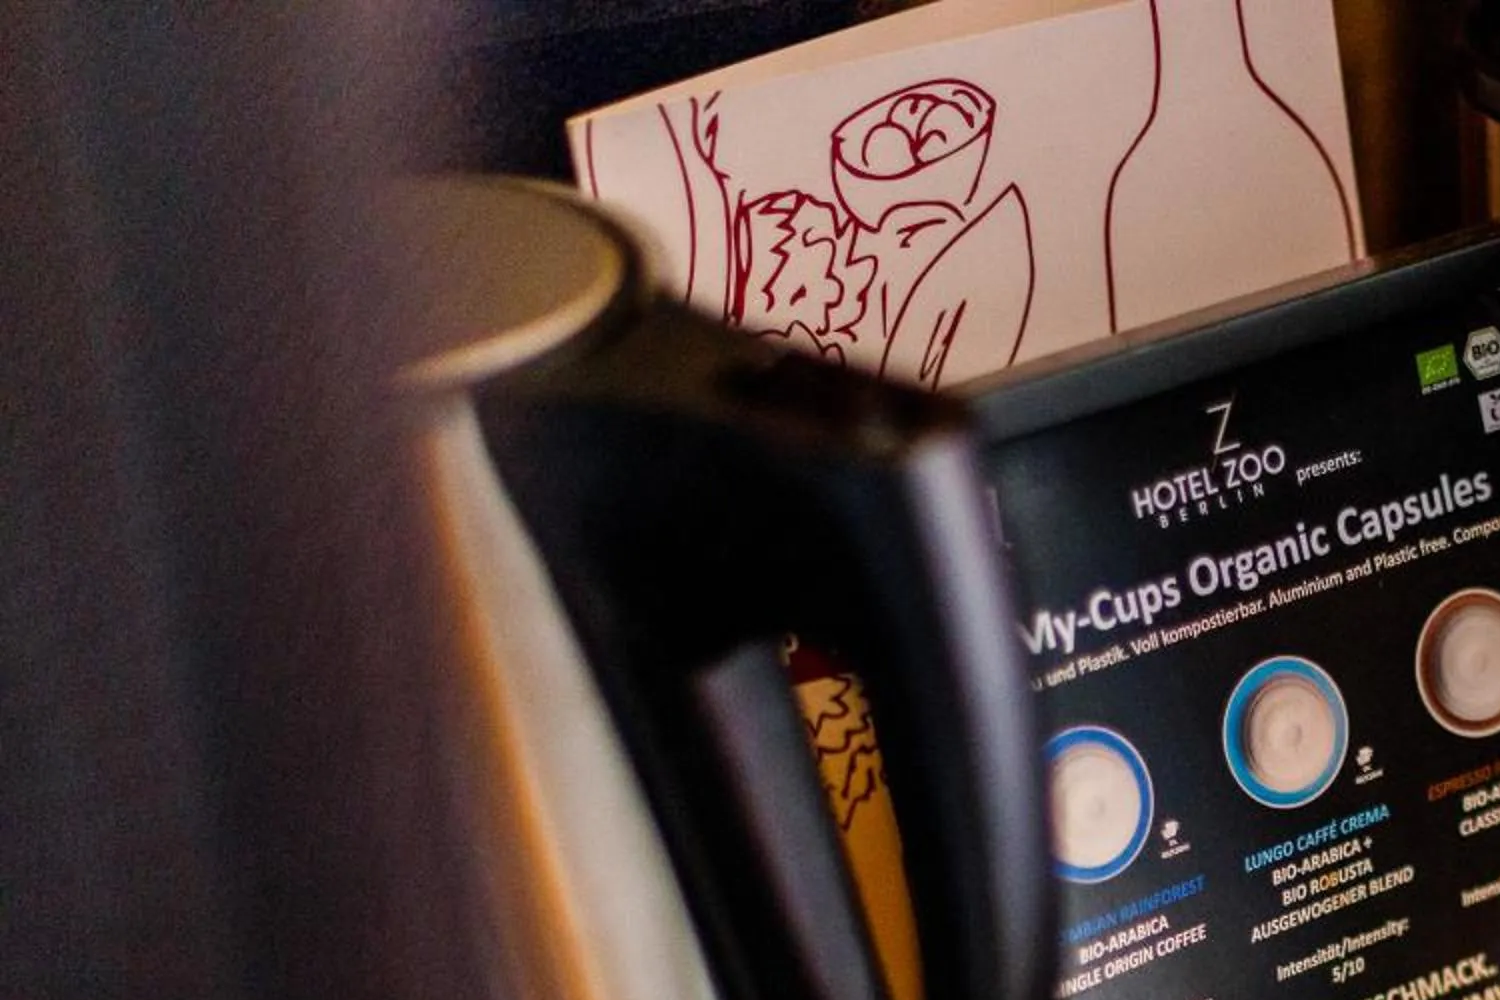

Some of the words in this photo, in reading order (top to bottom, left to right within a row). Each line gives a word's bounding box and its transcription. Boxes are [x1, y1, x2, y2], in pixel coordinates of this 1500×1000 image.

[1471, 340, 1500, 361] BIO
[1205, 399, 1242, 456] Z
[1131, 466, 1219, 519] HOTEL
[1222, 445, 1286, 490] ZOO
[1296, 450, 1362, 487] presents:
[1159, 483, 1265, 529] BERLIN
[1188, 521, 1330, 592] Organic
[1336, 469, 1493, 546] Capsules
[1047, 662, 1077, 687] und
[1078, 644, 1131, 676] Plastik.
[1131, 631, 1160, 657] Voll
[1161, 598, 1267, 647] kompostierbar.
[1269, 570, 1344, 609] Aluminium
[1346, 557, 1373, 582] and
[1374, 545, 1418, 573] Plastic
[1419, 534, 1451, 556] free.
[1428, 764, 1492, 801] ESPRESSO
[1244, 840, 1294, 872] LUNGO
[1340, 803, 1391, 834] CREMA
[1271, 840, 1363, 886] BIO-ARABICA
[1119, 874, 1206, 925] RAINFOREST
[1251, 884, 1368, 943] AUSGEWOGENER
[1369, 865, 1415, 897] BLEND
[1281, 885, 1308, 906] BIO
[1310, 858, 1375, 895] ROBUSTA
[1057, 967, 1103, 999] INGLE
[1104, 945, 1155, 979] ORIGIN
[1156, 922, 1207, 957] COFFEE
[1079, 914, 1170, 965] BIO-ARABICA
[1332, 956, 1366, 984] 5/10
